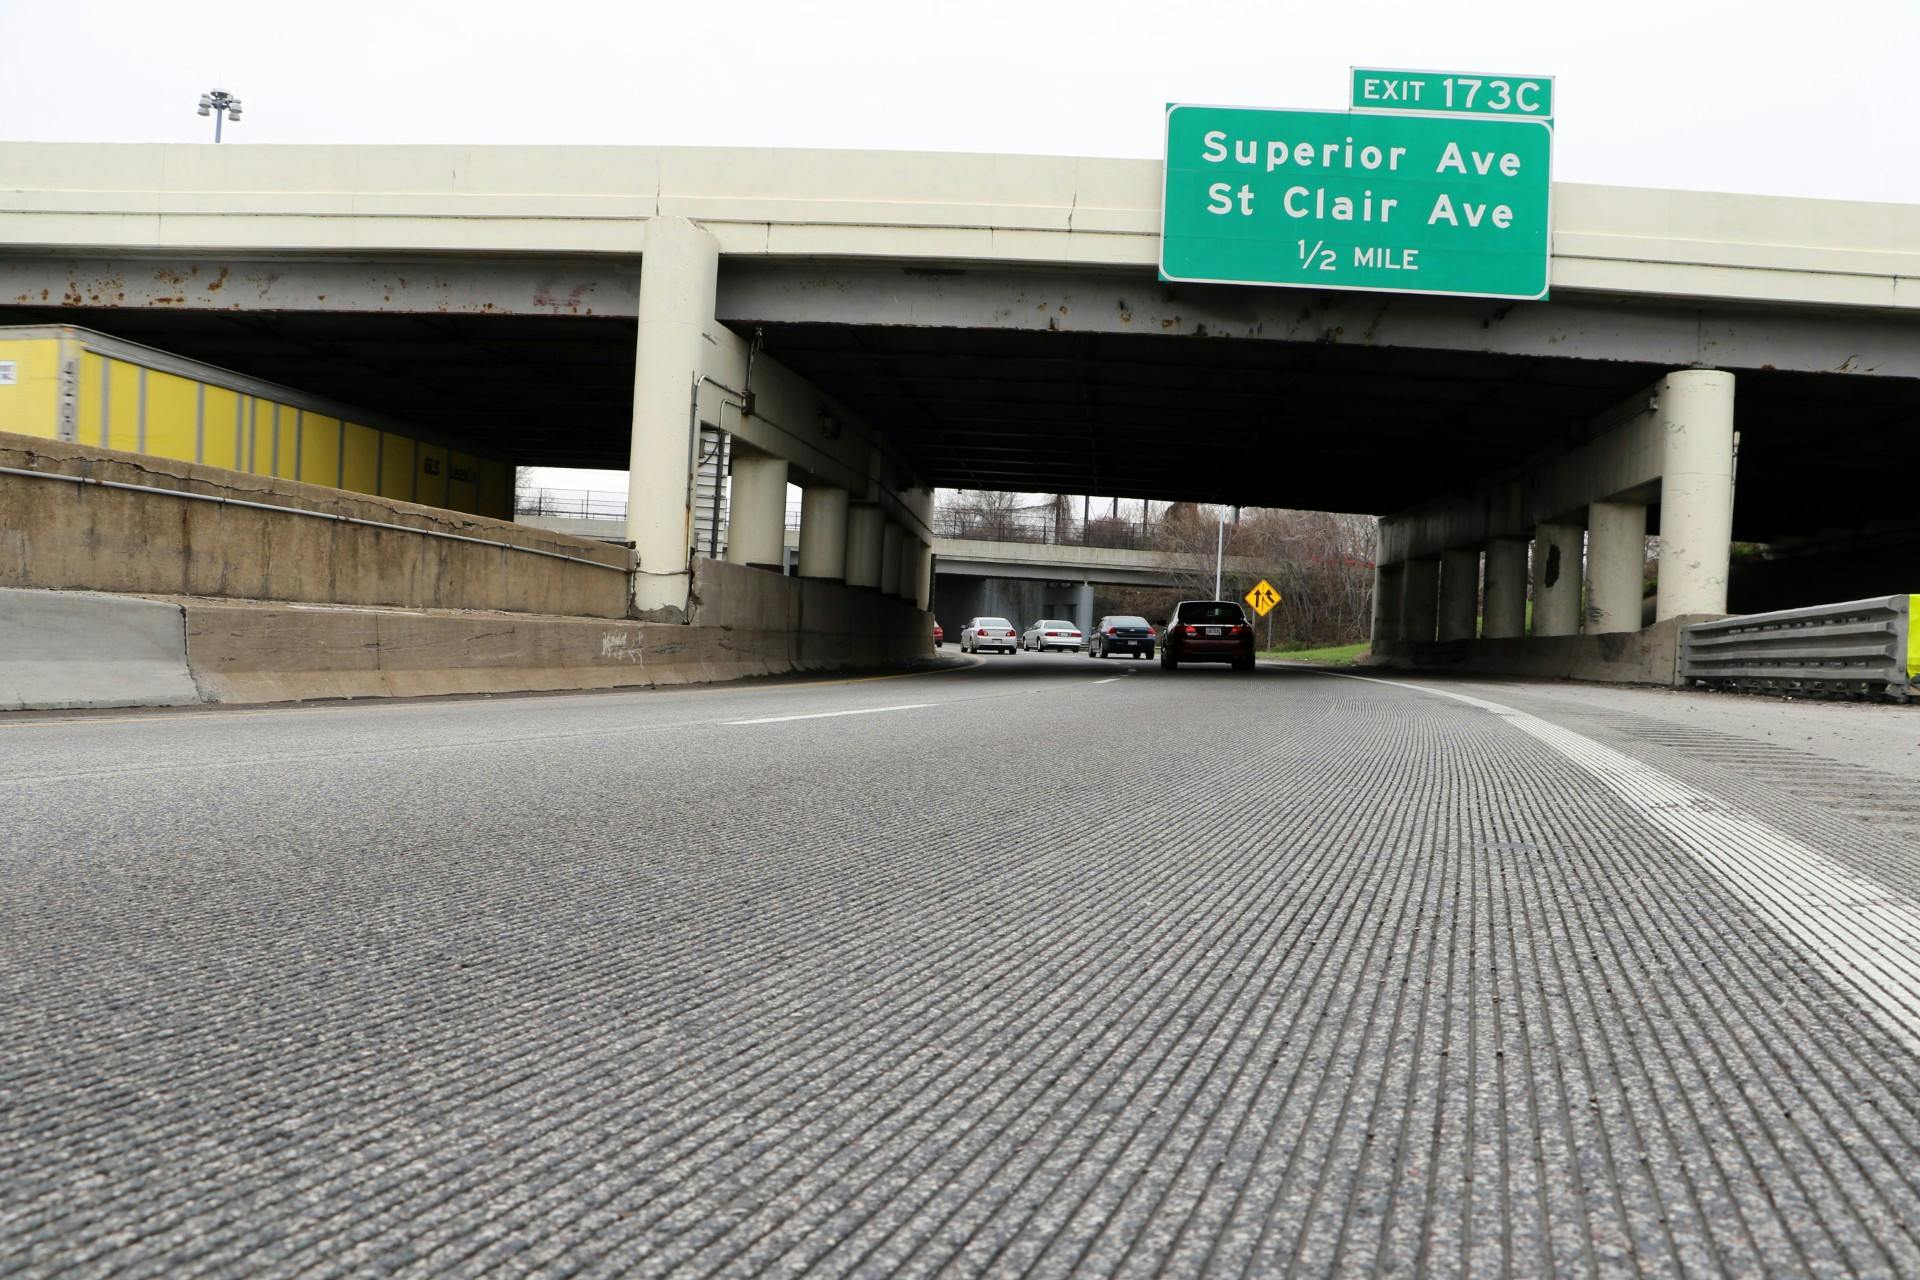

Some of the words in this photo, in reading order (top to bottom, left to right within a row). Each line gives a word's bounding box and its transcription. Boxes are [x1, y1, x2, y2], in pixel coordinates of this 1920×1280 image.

[1364, 78, 1425, 101] EXIT
[1443, 77, 1540, 111] 173C
[1202, 130, 1407, 172] Superior
[1436, 142, 1521, 177] Ave
[1207, 182, 1255, 216] St
[1283, 185, 1398, 223] Clair
[1427, 193, 1514, 229] Ave
[1354, 246, 1419, 271] MILE
